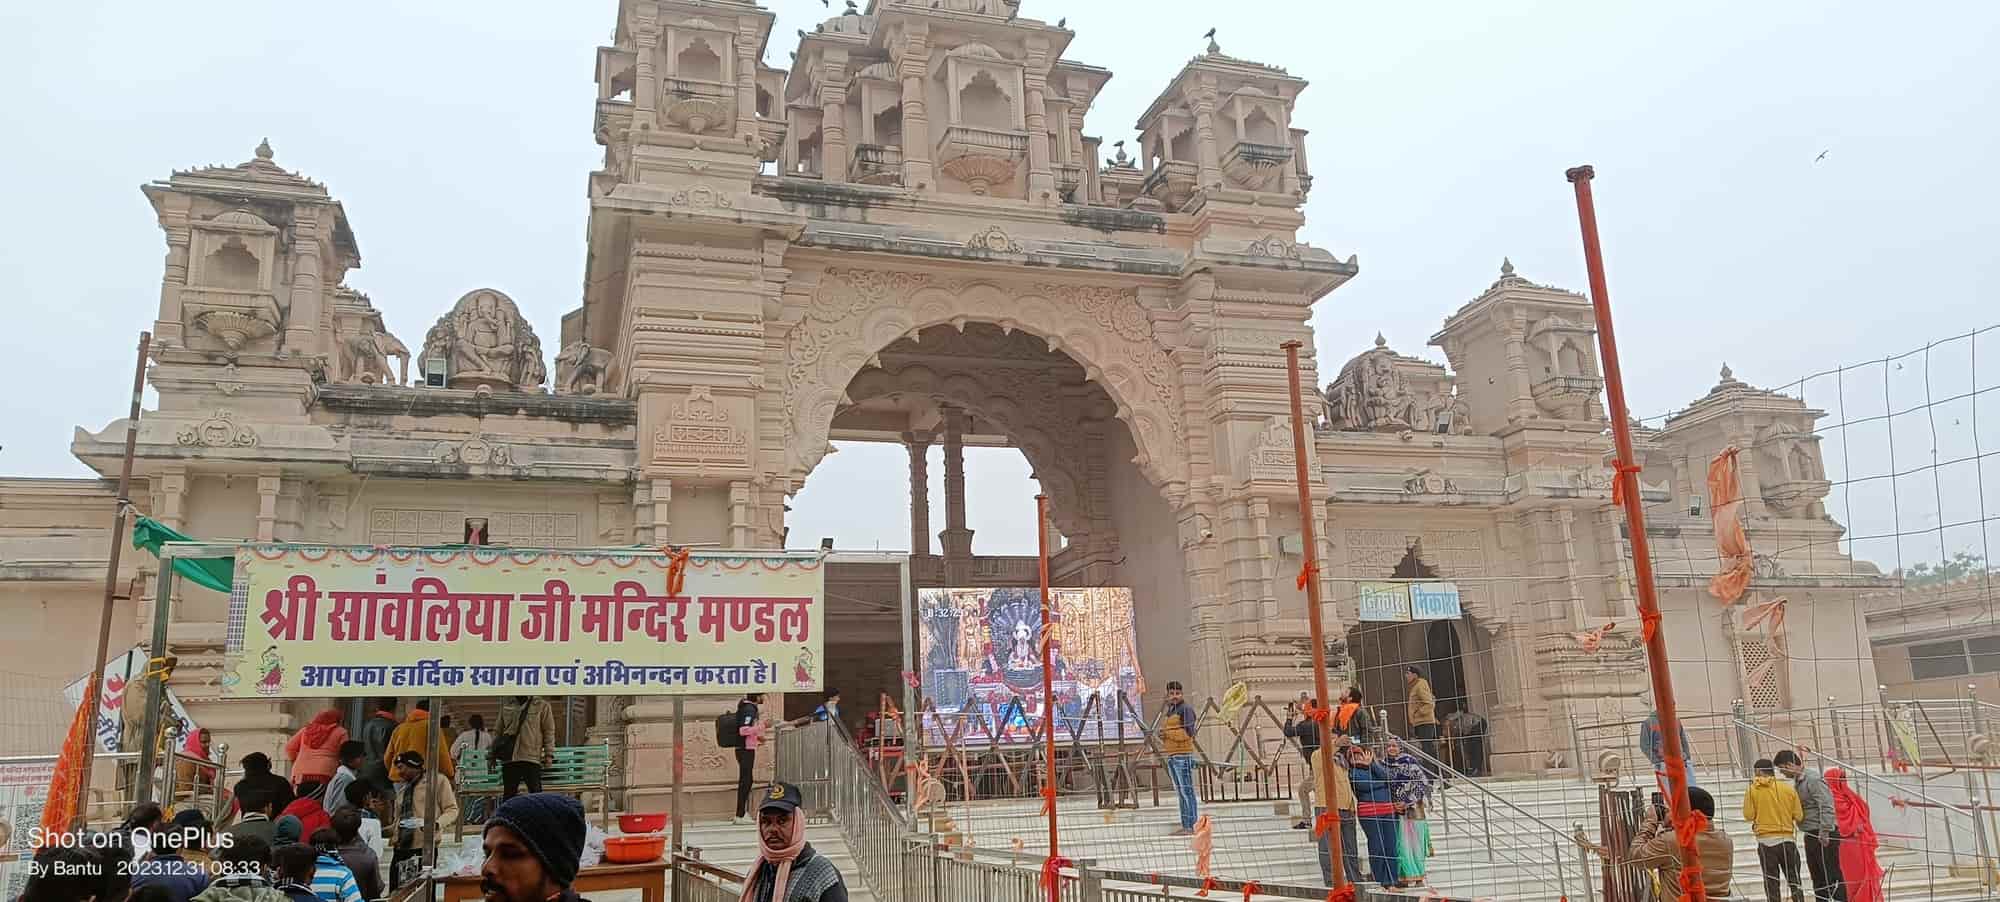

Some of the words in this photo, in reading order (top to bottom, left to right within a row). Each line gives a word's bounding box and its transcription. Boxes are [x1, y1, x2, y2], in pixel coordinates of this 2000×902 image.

[260, 575, 322, 641] श्री
[328, 574, 514, 641] सांवलिया
[520, 580, 575, 641] जी
[581, 581, 691, 642] मन्दिर
[698, 597, 812, 642] मण्डल
[301, 666, 388, 686] आपका
[391, 659, 465, 686] हार्दिक
[470, 666, 541, 686] स्वागत
[544, 659, 580, 685] एवं
[583, 660, 690, 685] अभिनन्दन
[694, 666, 749, 685] करता
